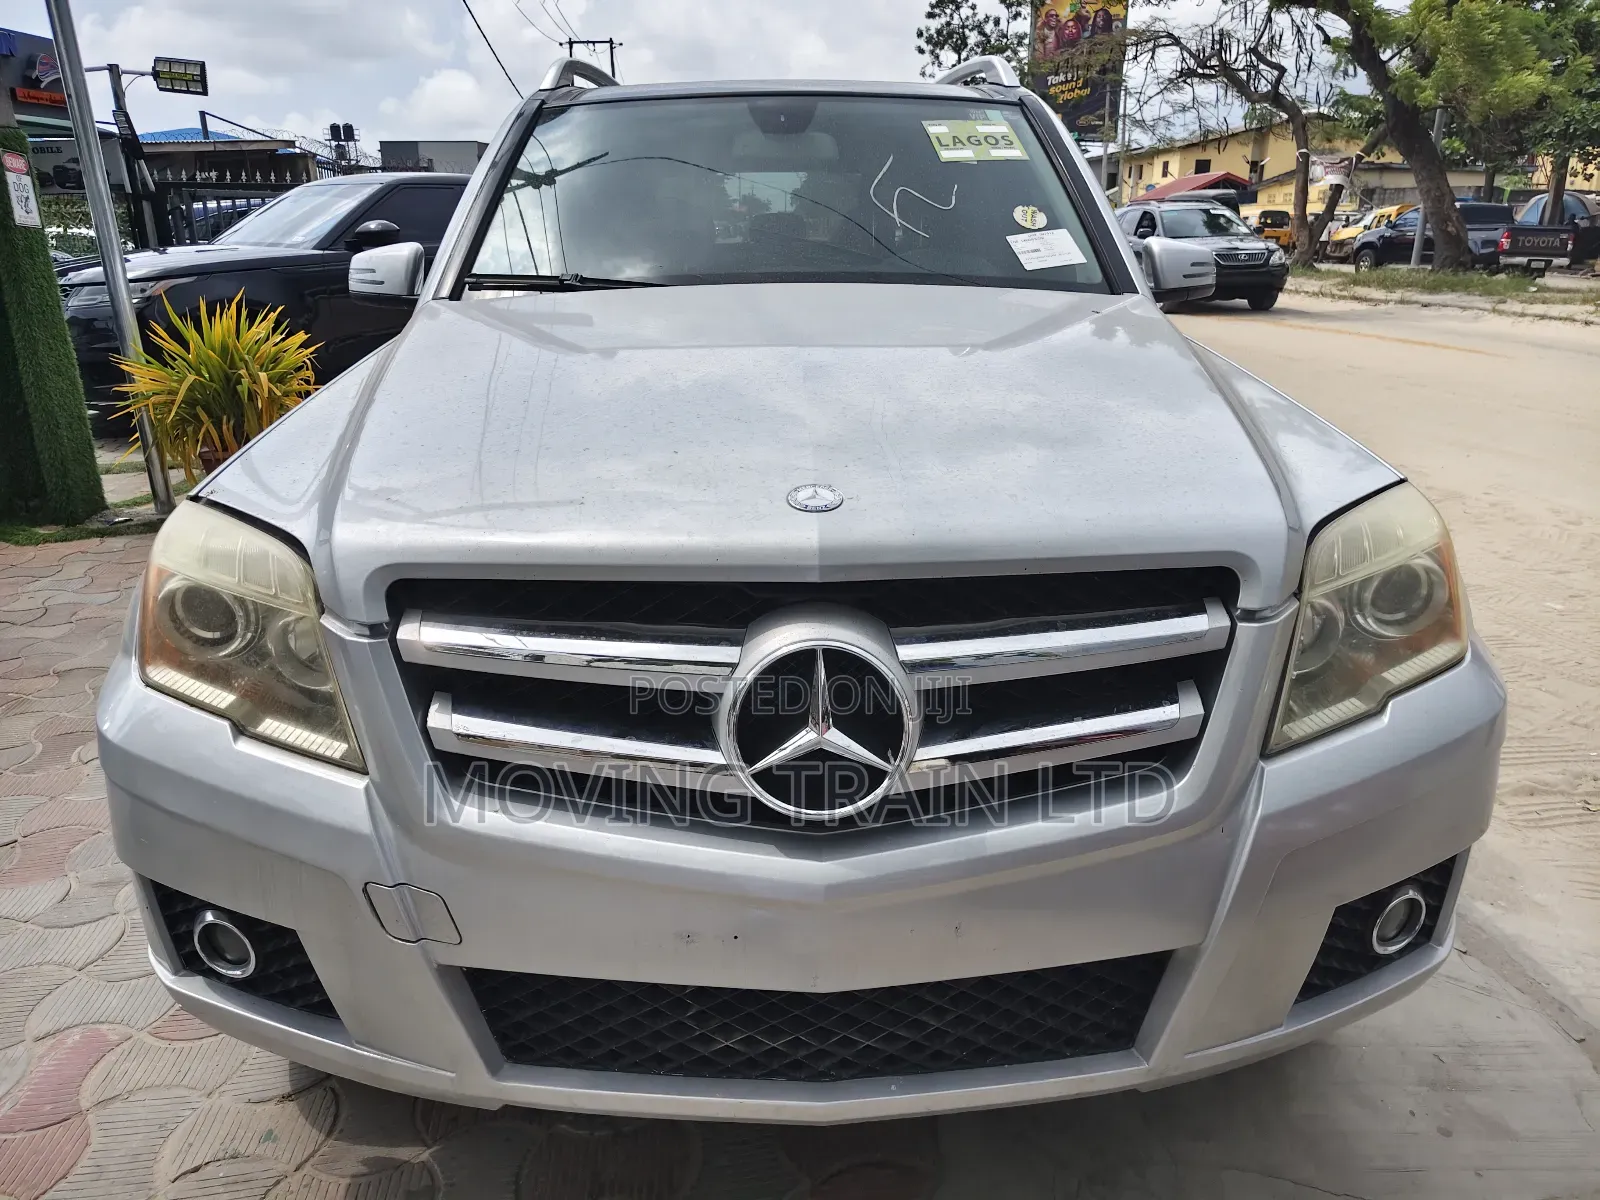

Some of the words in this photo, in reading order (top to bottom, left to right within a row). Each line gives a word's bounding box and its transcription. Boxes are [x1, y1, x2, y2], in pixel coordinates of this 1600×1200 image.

[1047, 72, 1072, 86] Take
[1048, 77, 1084, 95] sound
[935, 135, 1014, 147] LAGOS
[5, 155, 27, 171] BEWARE
[13, 181, 30, 194] DOG
[1518, 237, 1560, 247] TOYOTA
